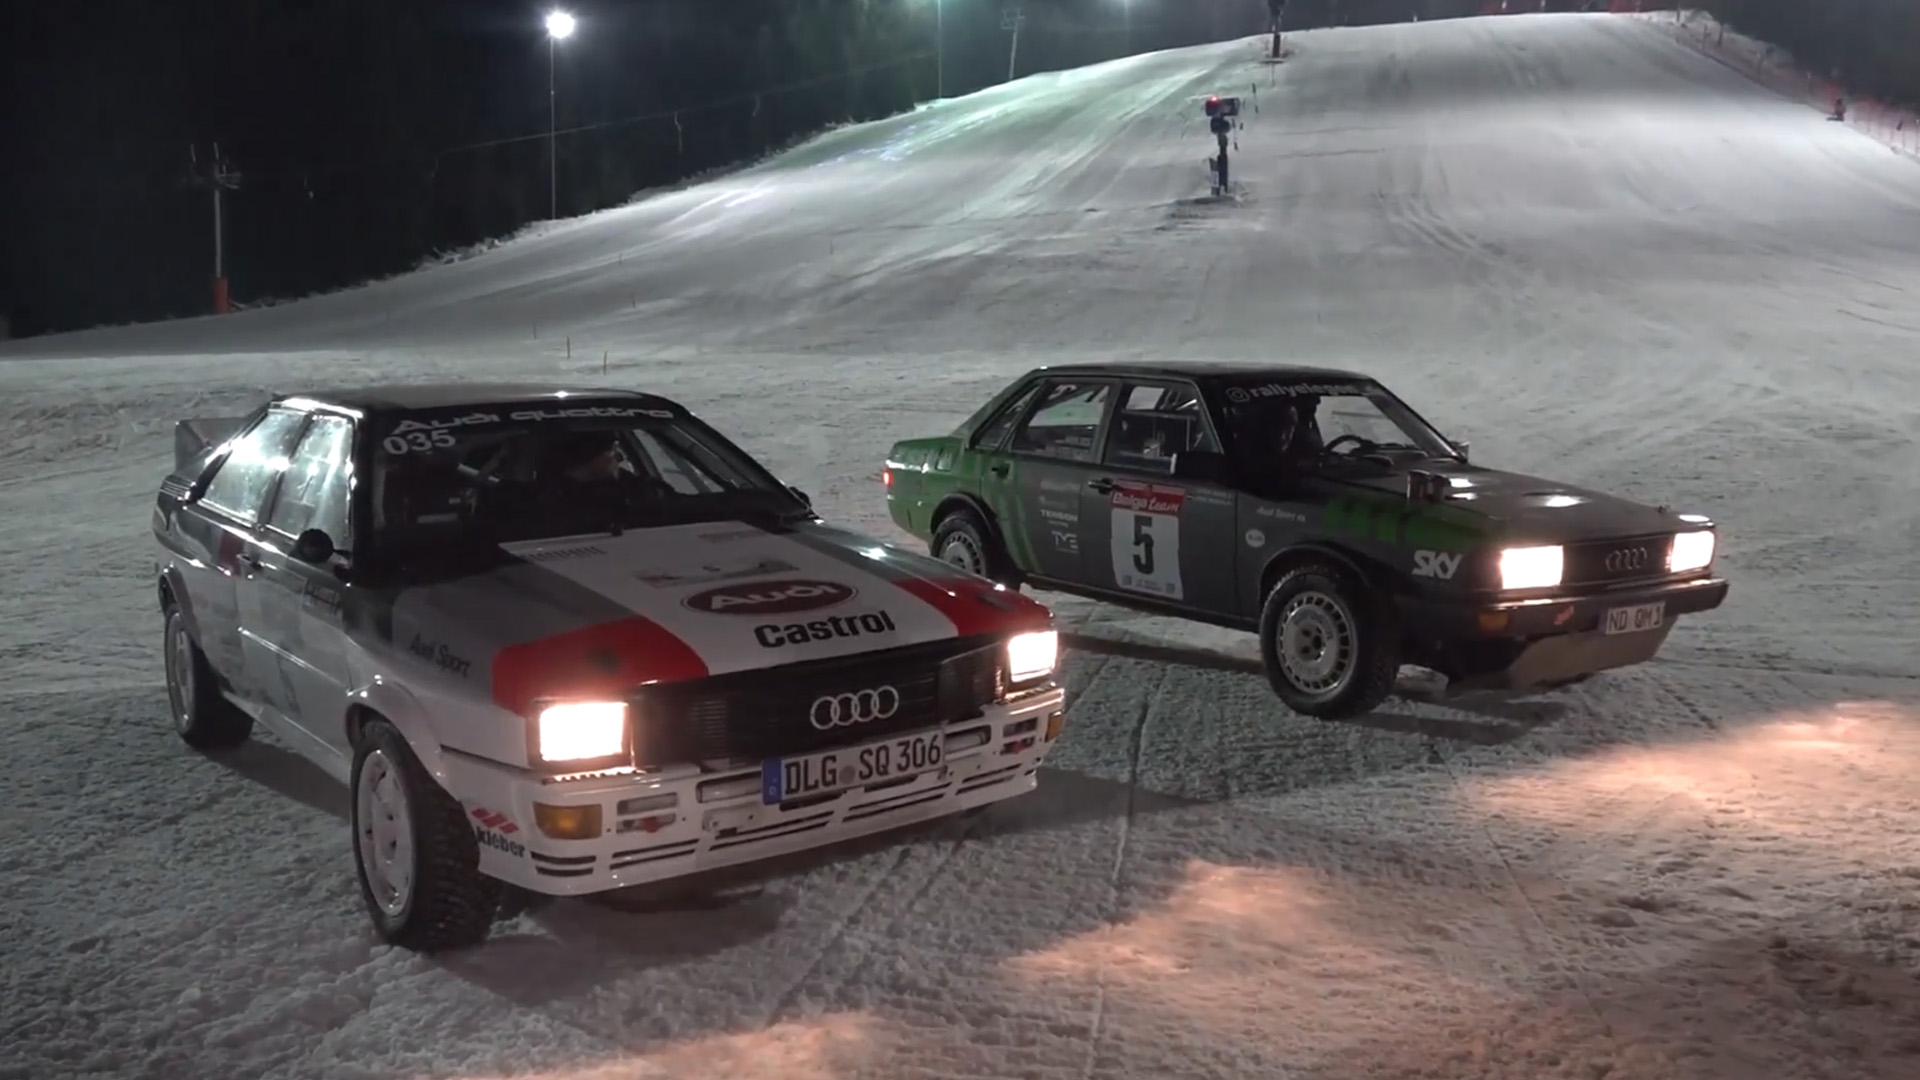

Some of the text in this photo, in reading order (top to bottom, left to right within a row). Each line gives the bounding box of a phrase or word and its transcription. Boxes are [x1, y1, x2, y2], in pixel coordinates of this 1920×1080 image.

[391, 407, 674, 436] Audi quattro
[382, 429, 456, 455] 035
[1148, 497, 1179, 512] team
[1132, 514, 1155, 575] 5
[1411, 549, 1463, 580] SKY
[710, 584, 843, 610] Audi
[753, 610, 896, 649] Castrol
[1608, 609, 1628, 632] ND
[406, 632, 471, 679] Audi Sport
[784, 734, 941, 795] DLG SQ 306
